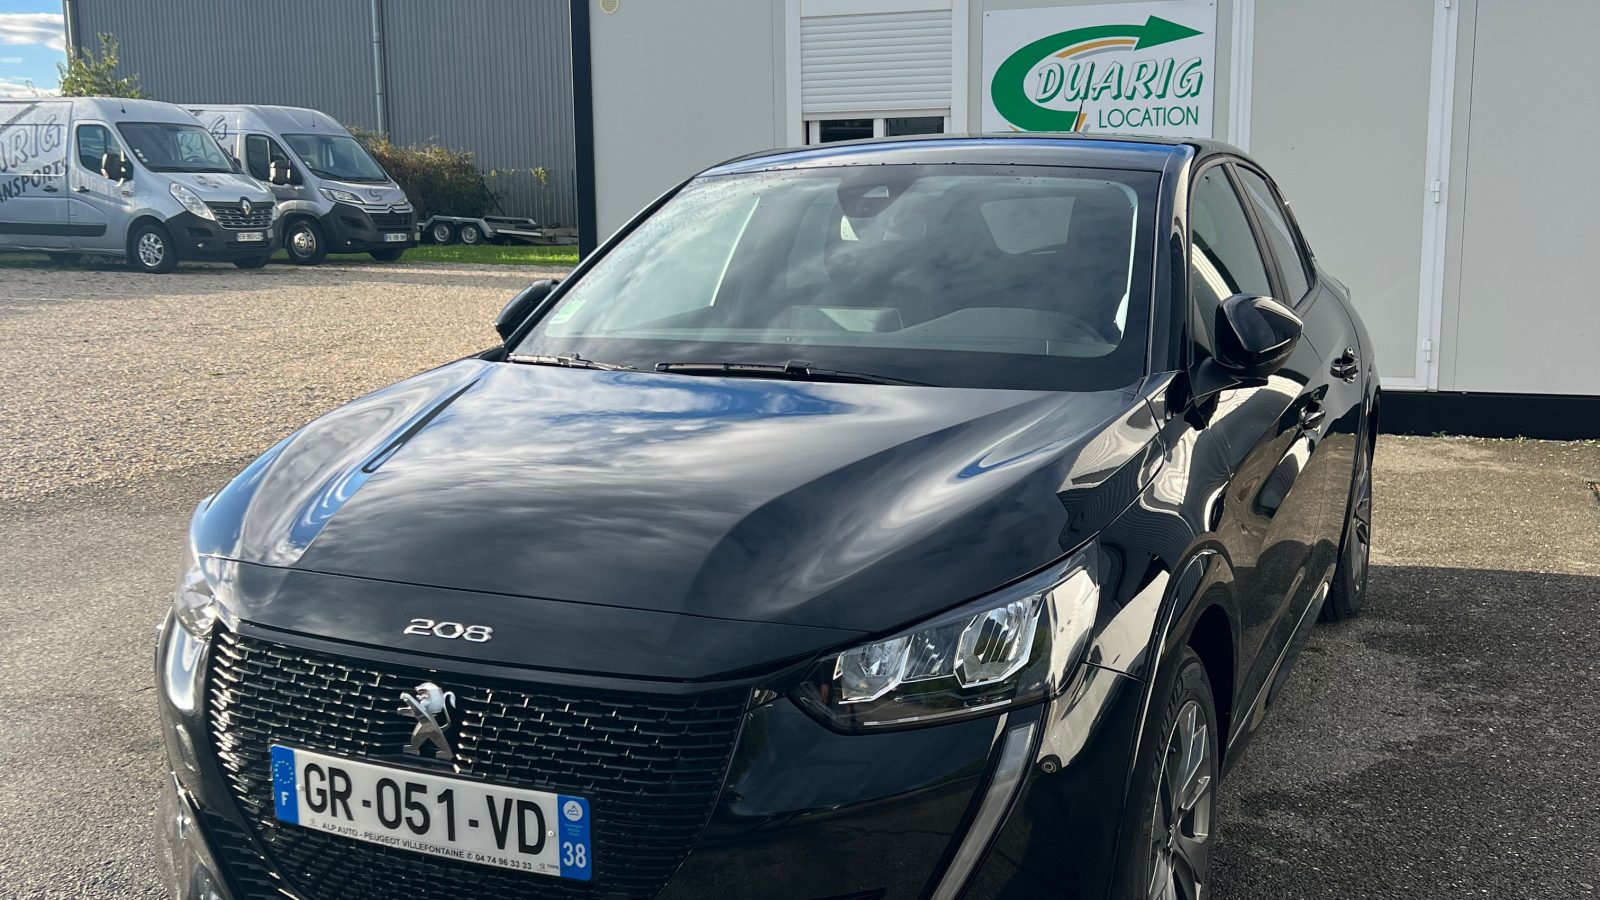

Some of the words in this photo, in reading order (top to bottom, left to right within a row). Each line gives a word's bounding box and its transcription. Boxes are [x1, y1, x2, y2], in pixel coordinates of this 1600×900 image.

[1034, 57, 1204, 103] DUARIG
[1098, 106, 1199, 128] LOCATION
[403, 618, 493, 642] 208
[280, 791, 290, 806] F
[303, 762, 547, 855] GR-051-VD
[322, 822, 336, 832] ALP
[337, 826, 358, 837] AUTO
[364, 832, 401, 845] PEUGEOT
[402, 840, 465, 859] VILLEFONTAINE
[475, 854, 485, 862] 04
[487, 856, 497, 864] 74
[498, 858, 509, 866] 96
[510, 860, 520, 868] 33
[522, 861, 532, 870] 33
[563, 841, 587, 869] 38
